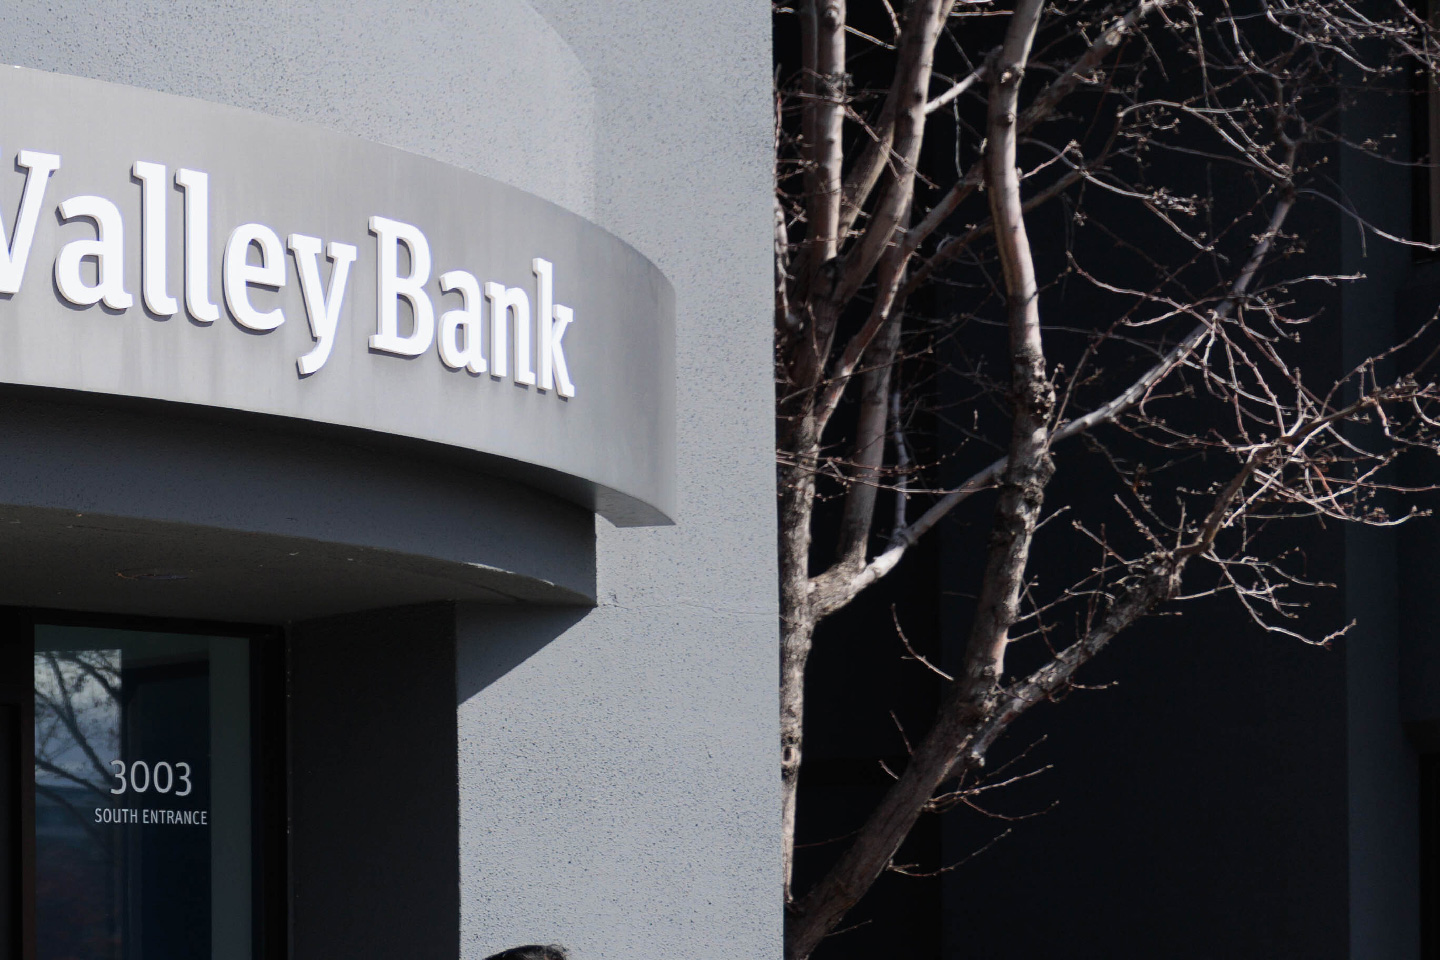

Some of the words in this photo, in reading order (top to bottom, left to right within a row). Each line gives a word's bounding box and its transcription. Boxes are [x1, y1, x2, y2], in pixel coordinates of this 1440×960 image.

[368, 214, 576, 399] Bank
[110, 759, 192, 797] 3003
[94, 808, 138, 824] SOUTH
[142, 809, 208, 825] ENTRANCE
